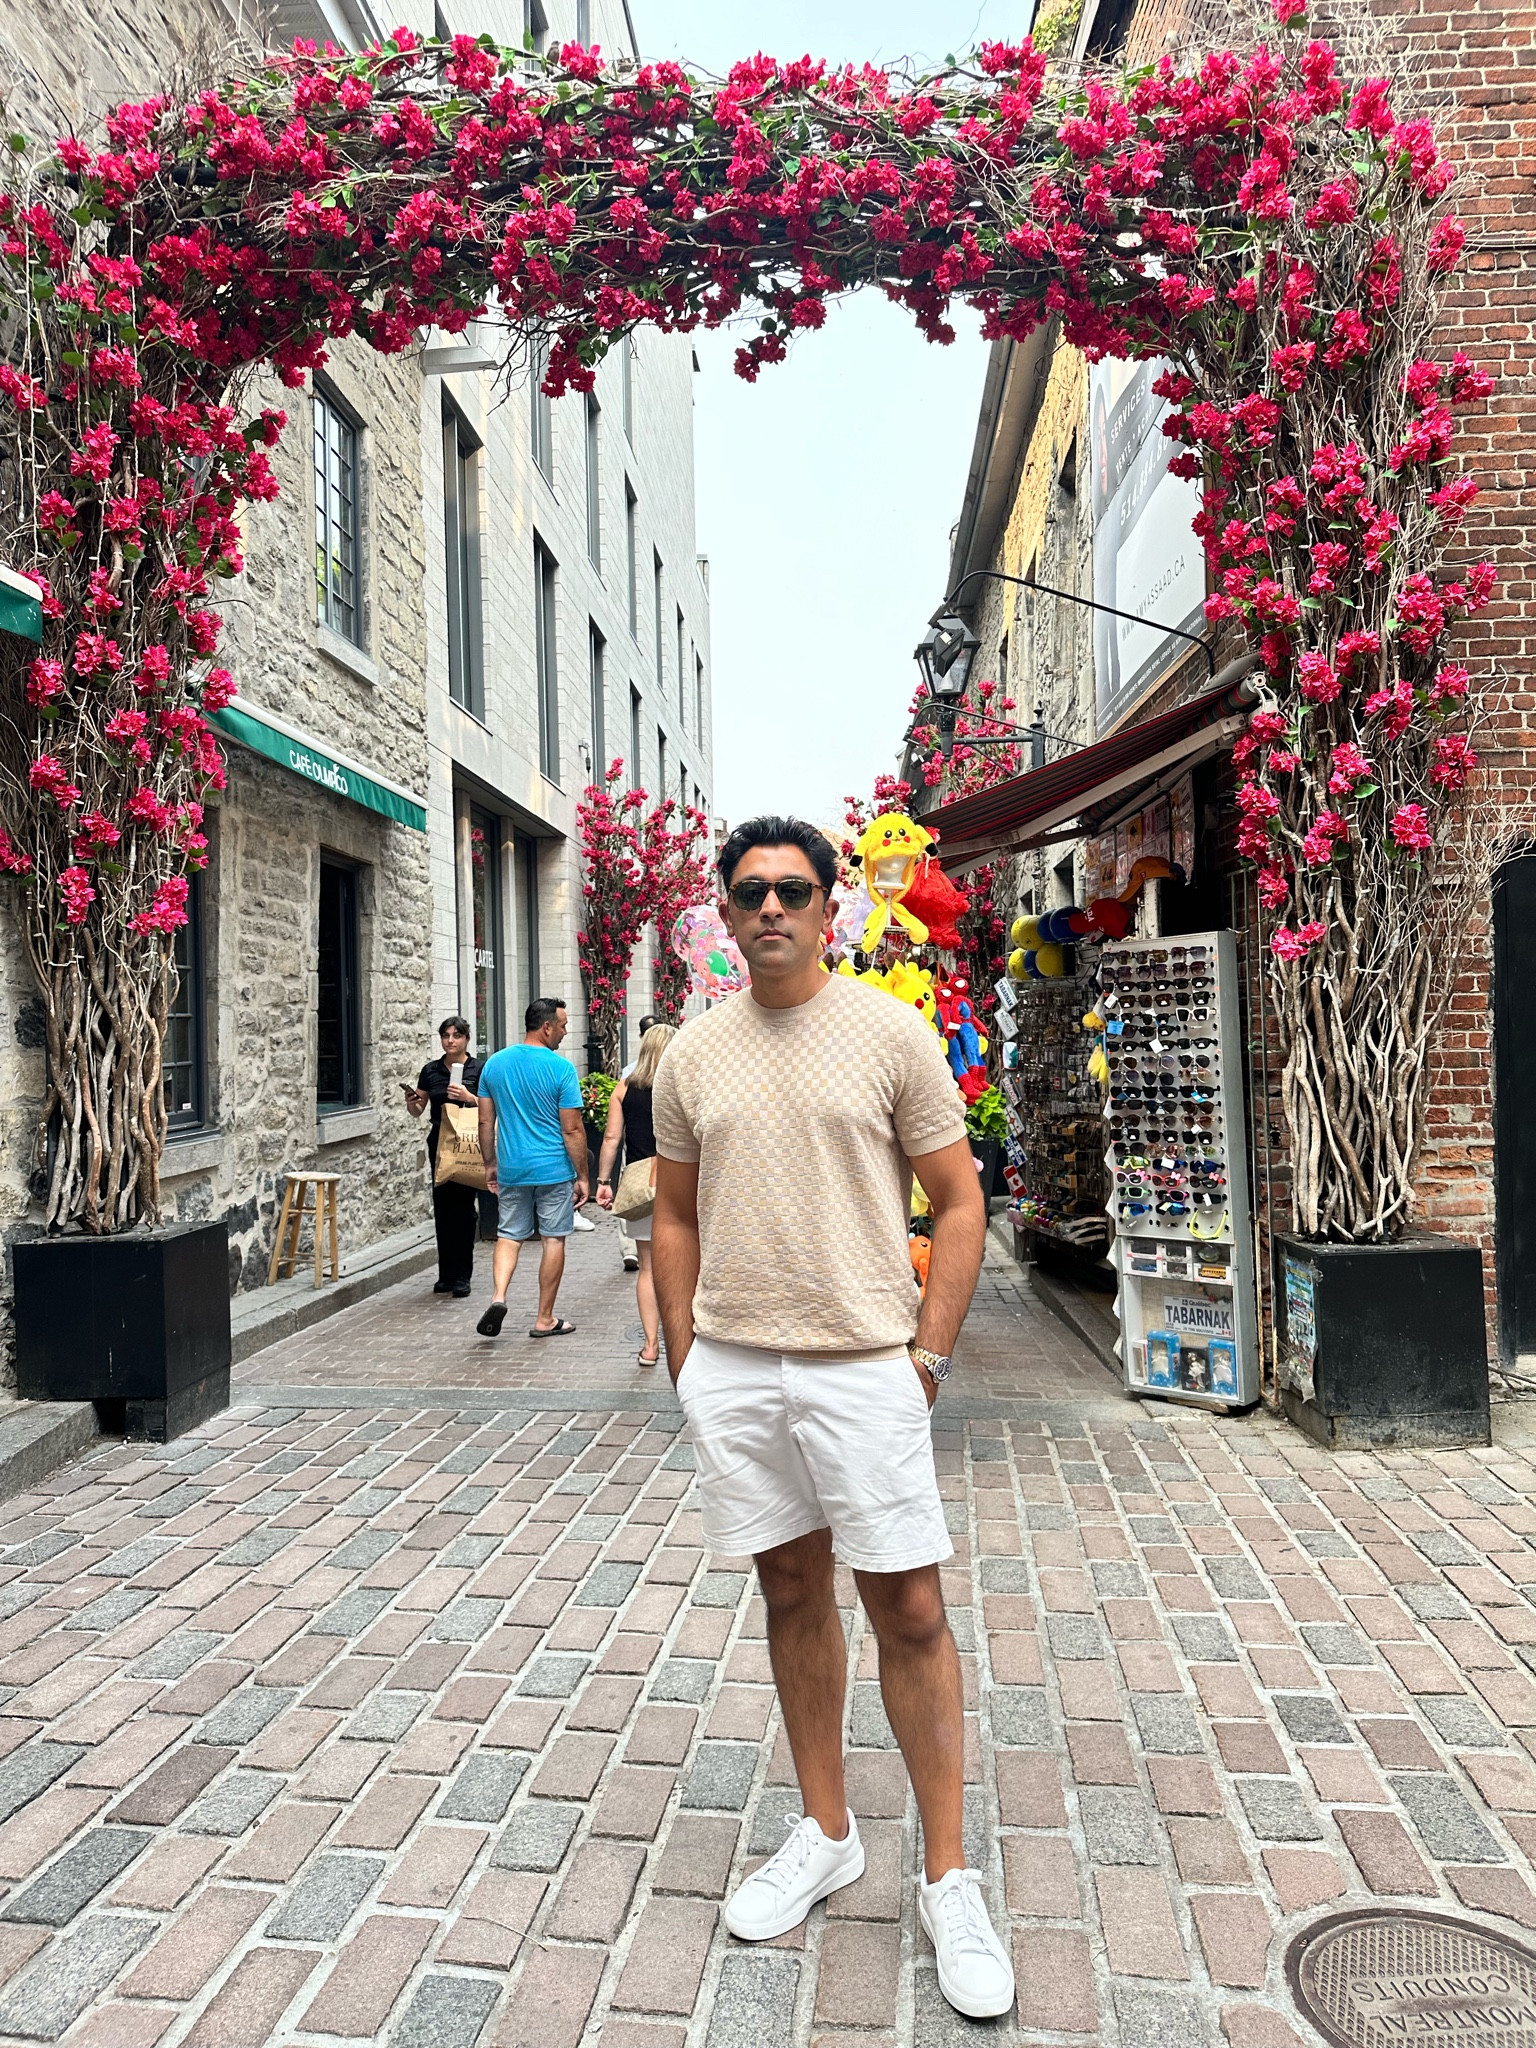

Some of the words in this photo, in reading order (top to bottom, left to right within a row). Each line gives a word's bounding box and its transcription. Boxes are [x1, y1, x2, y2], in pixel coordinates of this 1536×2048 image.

[1110, 378, 1146, 445] SERVICES
[1115, 441, 1132, 475] VENTE
[1137, 397, 1155, 437] ACHAT
[289, 749, 313, 777] CAFÉ
[312, 762, 349, 795] OLIMPICO
[474, 947, 495, 969] CARTEL
[452, 1142, 481, 1154] PLAN
[454, 1132, 480, 1143] URB
[1165, 1305, 1231, 1330] TABARNAK
[1351, 1974, 1511, 2003] CONDUITS
[1369, 2005, 1536, 2034] MONTREAL
